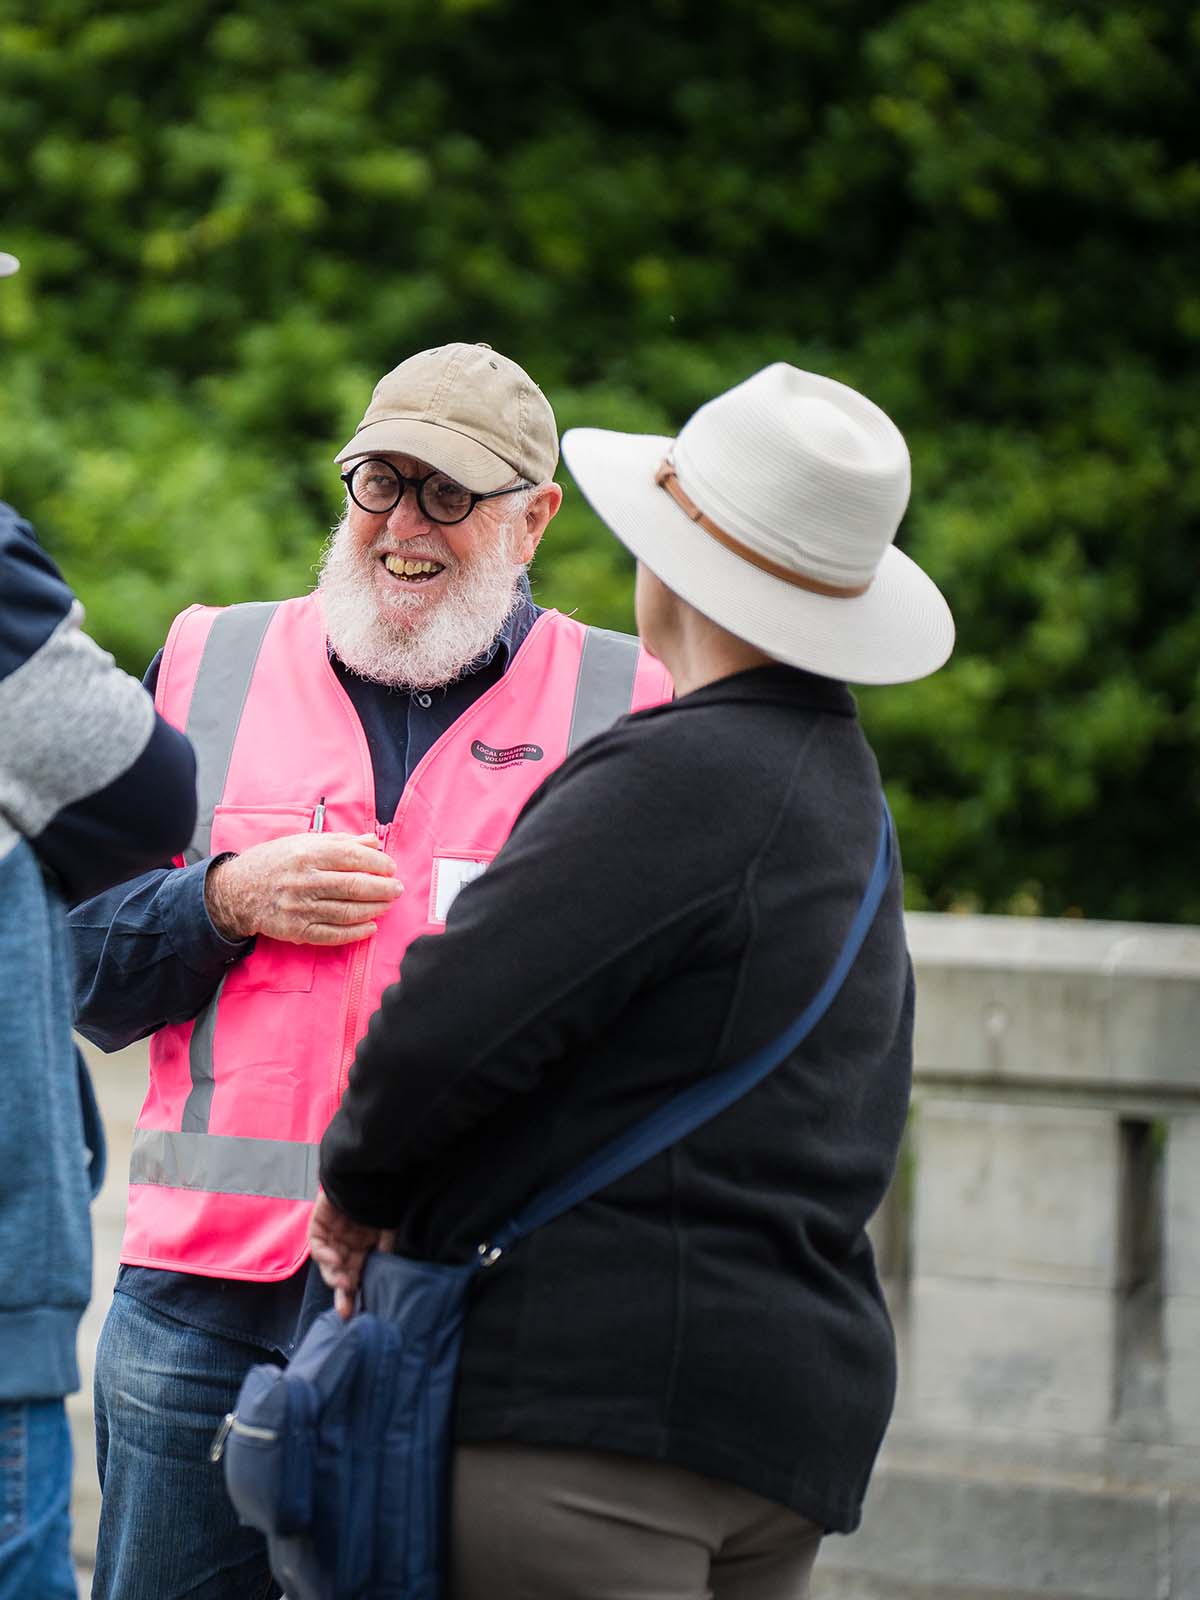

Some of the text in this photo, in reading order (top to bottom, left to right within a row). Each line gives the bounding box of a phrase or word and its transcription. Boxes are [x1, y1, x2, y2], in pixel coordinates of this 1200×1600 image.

[476, 744, 537, 757] LOCAL CHAMPION
[484, 752, 524, 762] VOLUNTEER
